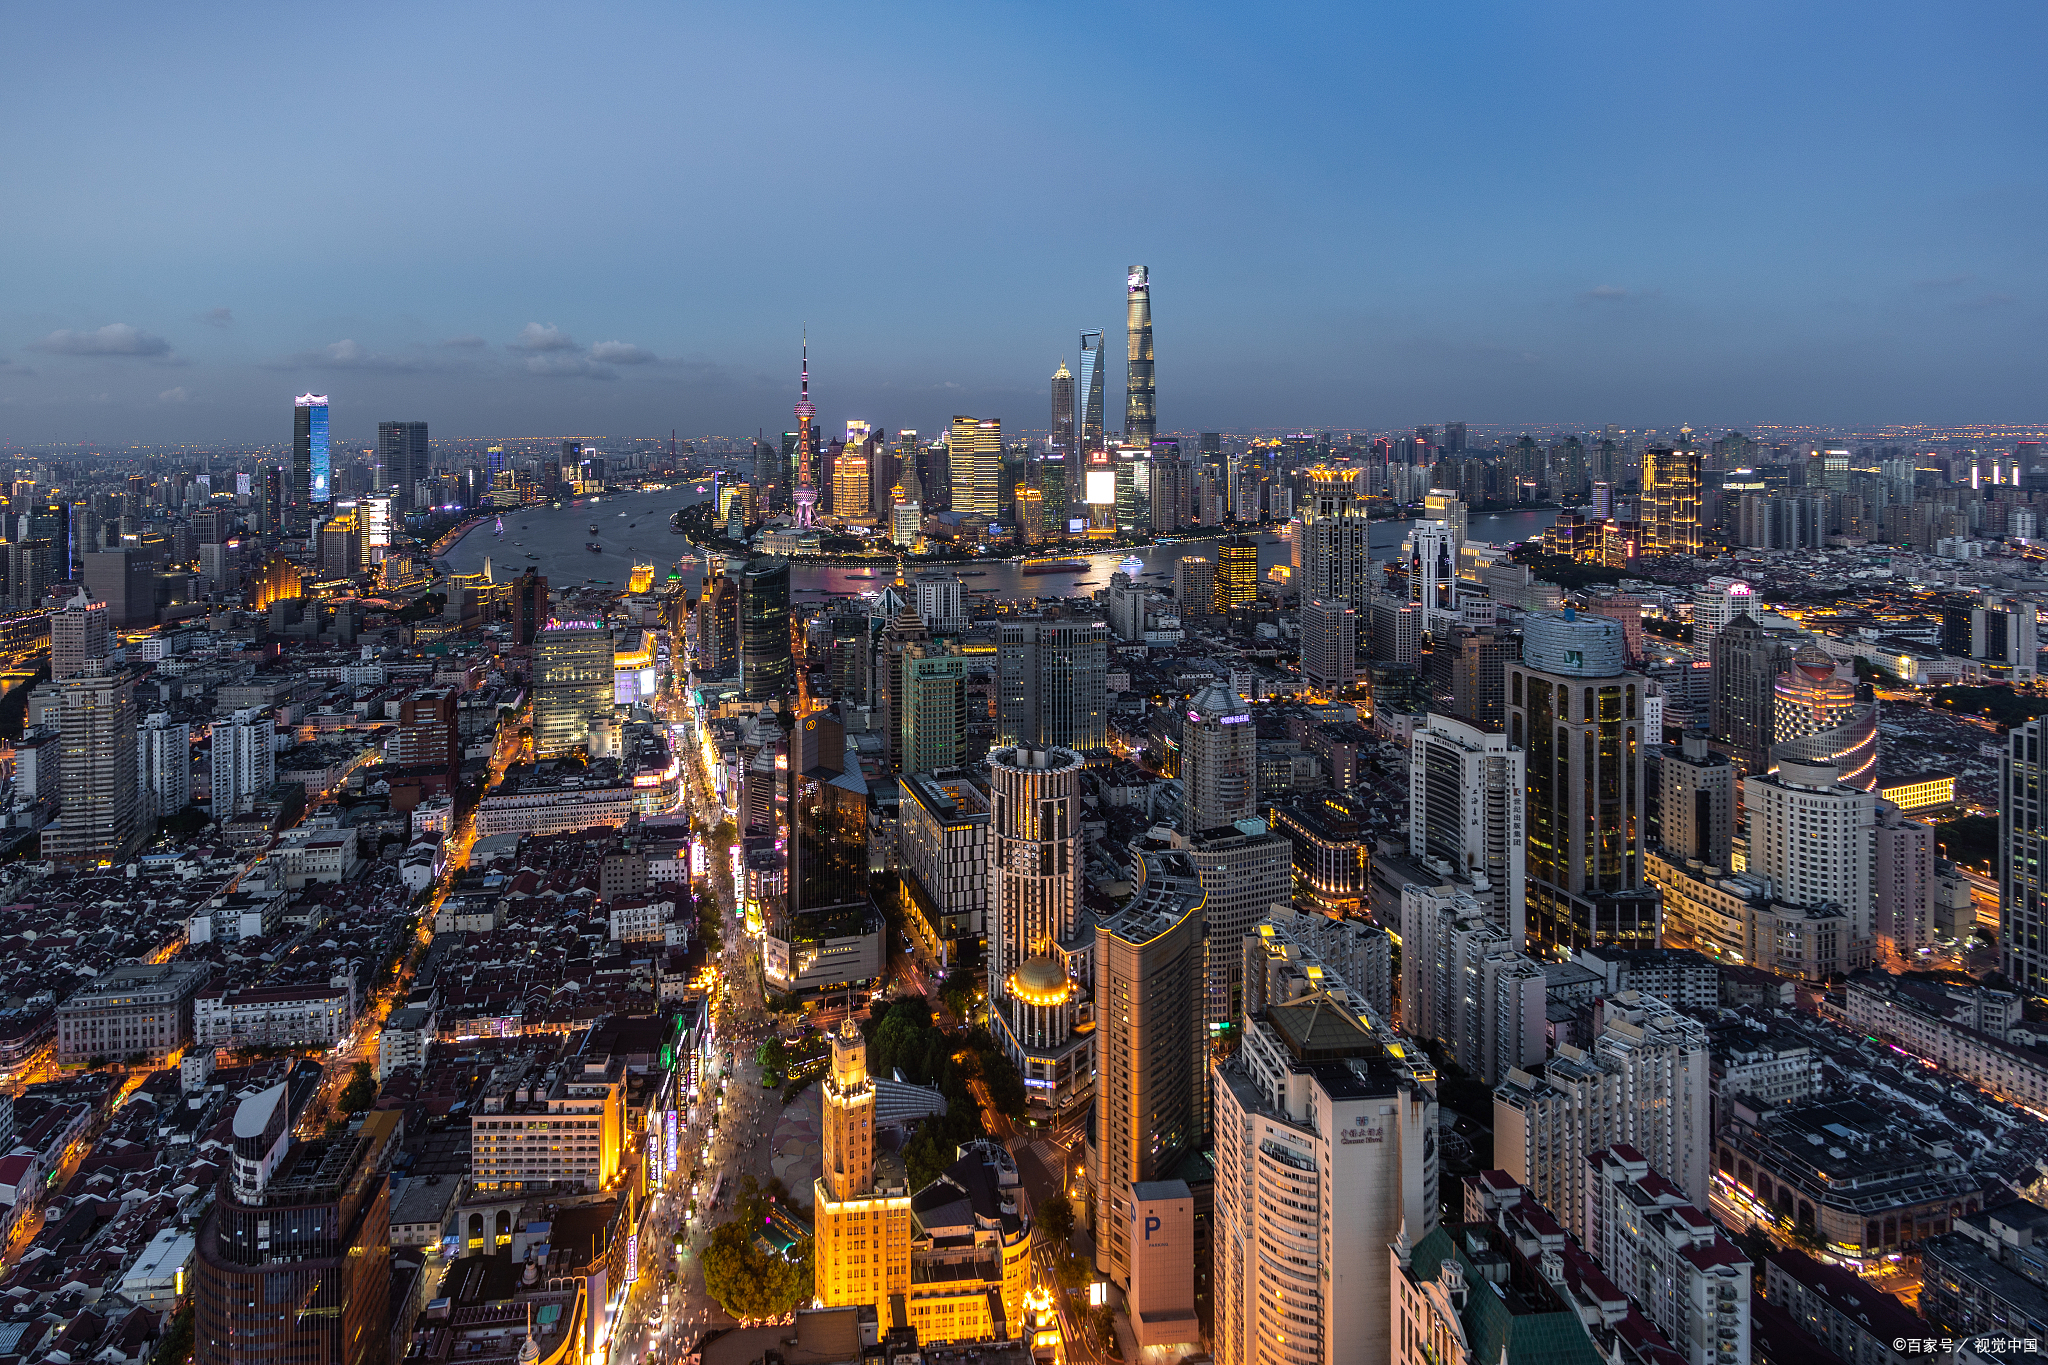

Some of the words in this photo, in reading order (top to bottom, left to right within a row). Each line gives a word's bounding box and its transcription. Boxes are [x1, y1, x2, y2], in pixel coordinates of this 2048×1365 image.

[1513, 797, 1522, 846] 世纪出版集团
[823, 946, 853, 954] SOFITEL
[1145, 1216, 1161, 1240] P
